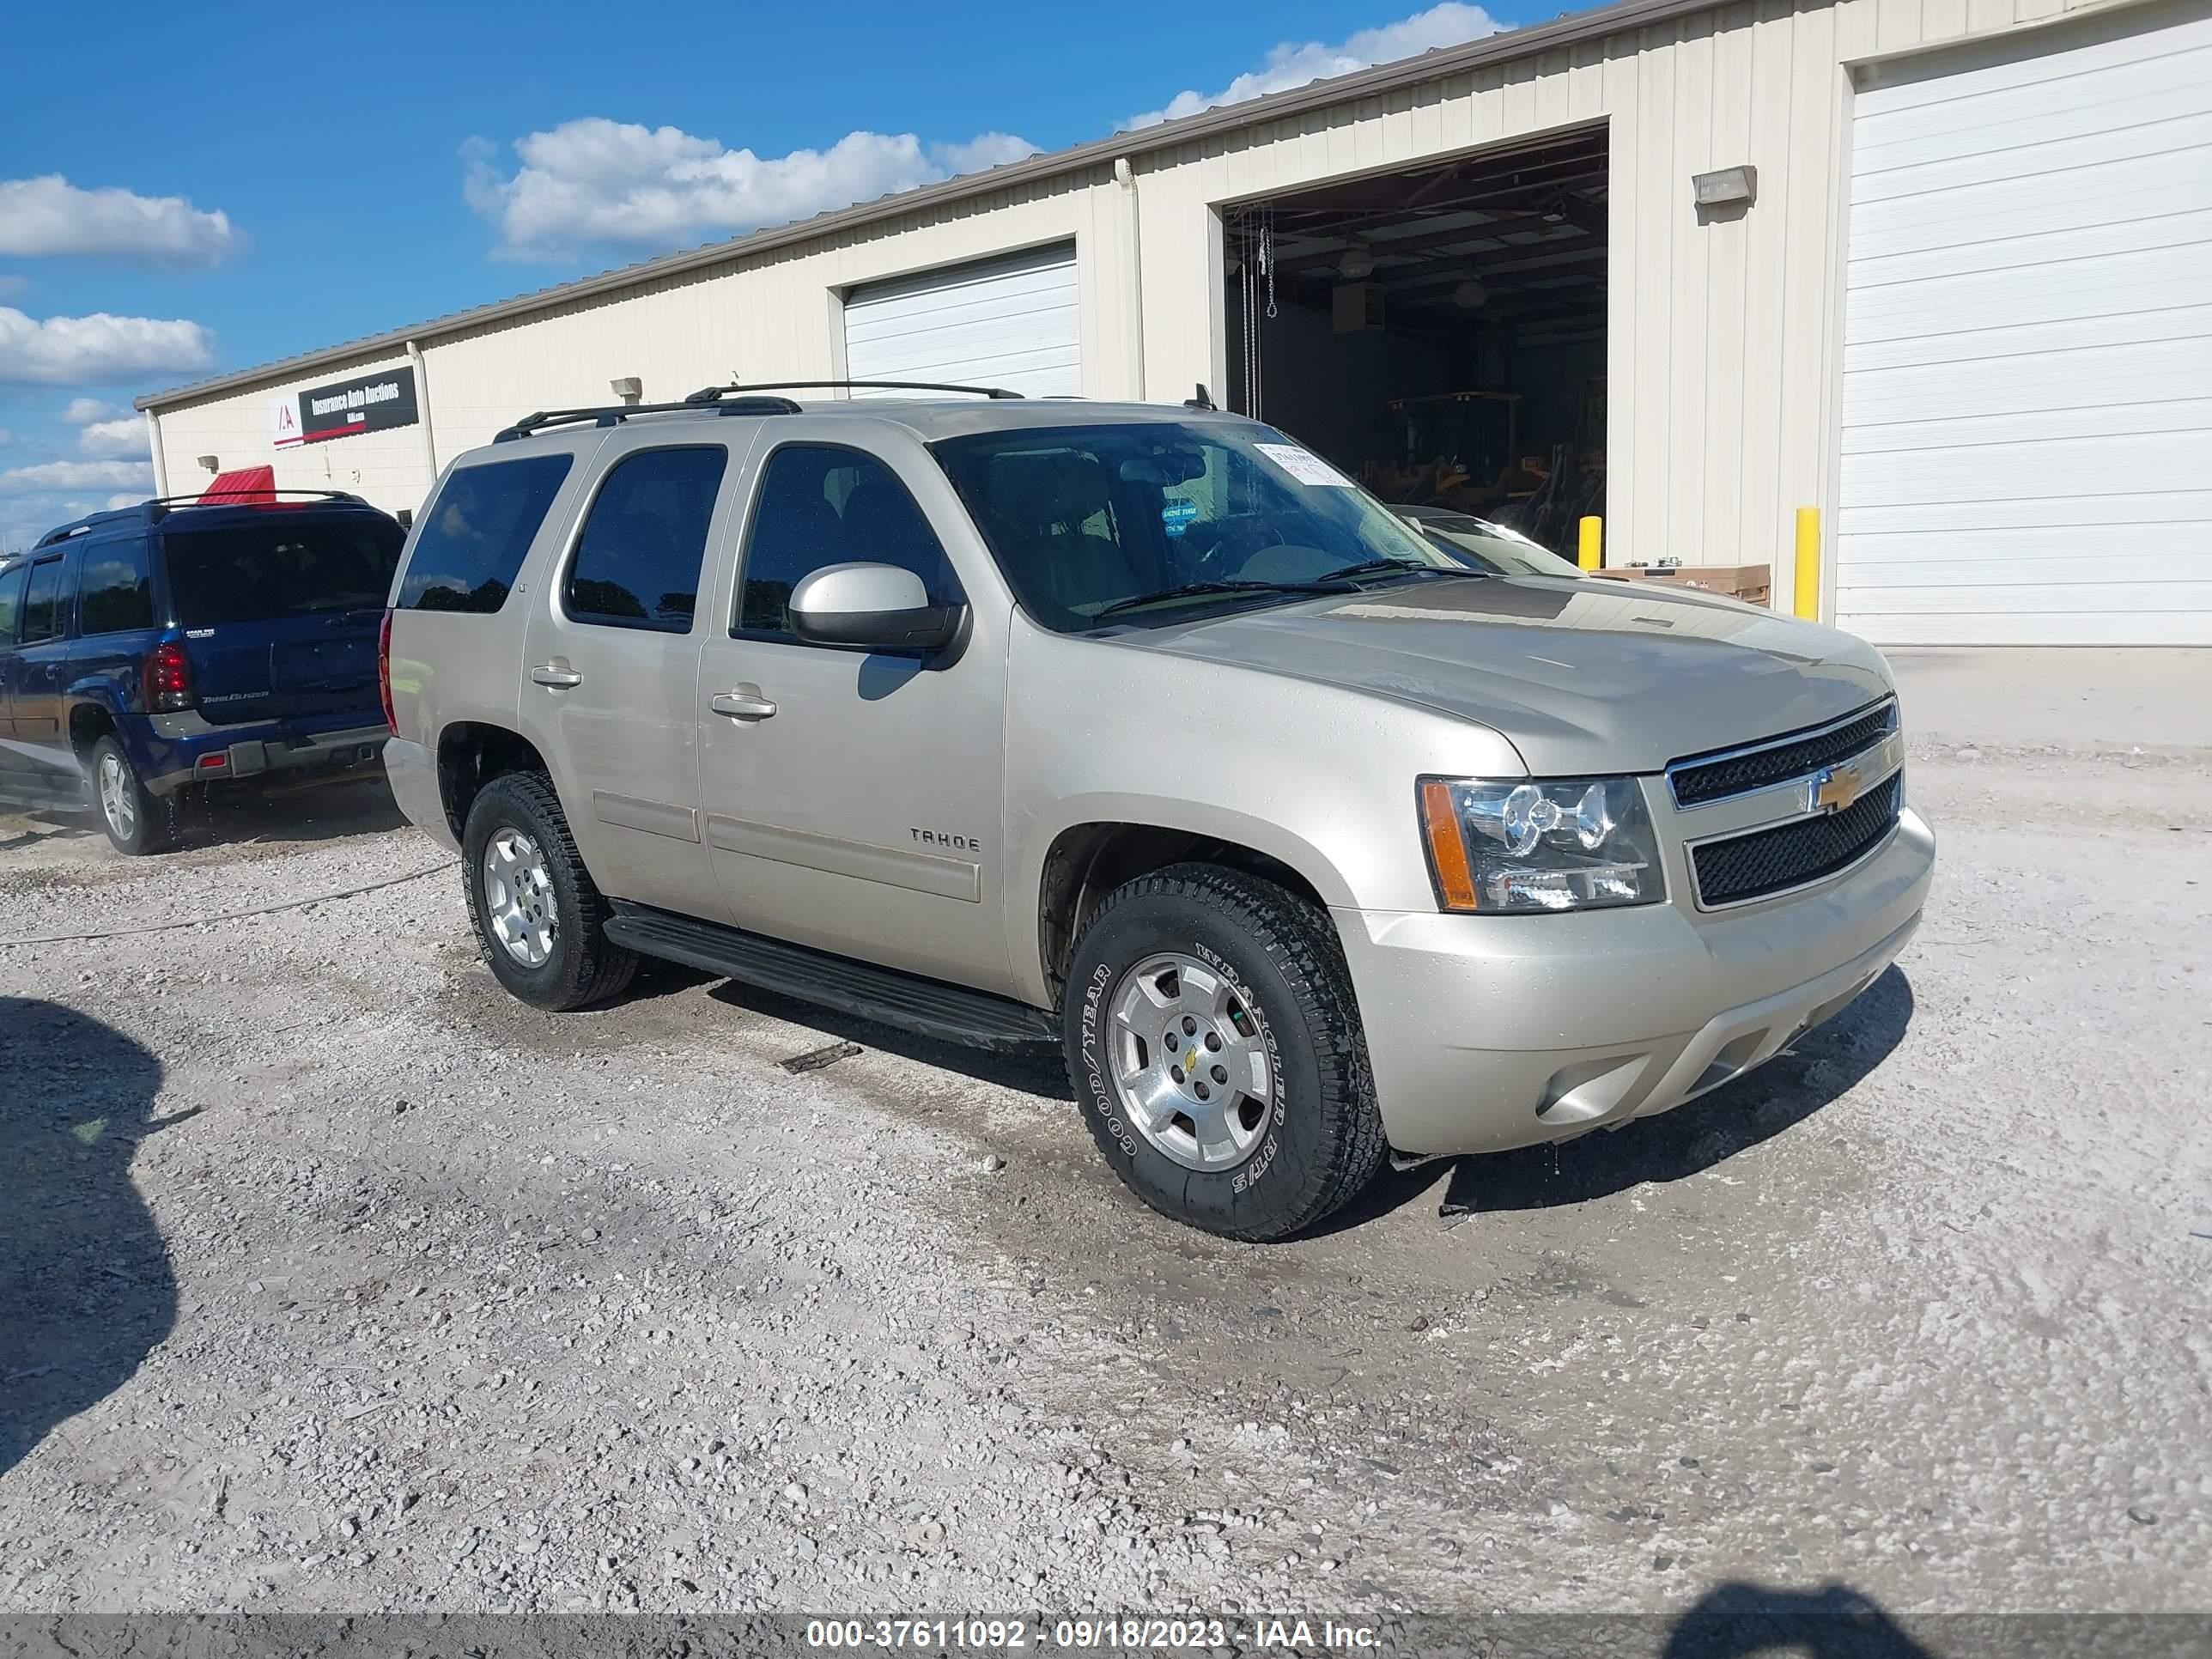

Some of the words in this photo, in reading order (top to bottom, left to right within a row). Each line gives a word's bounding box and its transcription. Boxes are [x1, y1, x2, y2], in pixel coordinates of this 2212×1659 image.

[312, 394, 348, 416] Insurance
[348, 389, 365, 409] Auto
[365, 382, 399, 405] Auctions
[910, 828, 981, 852] TAHOE
[1195, 942, 1285, 1127] WRANGLER
